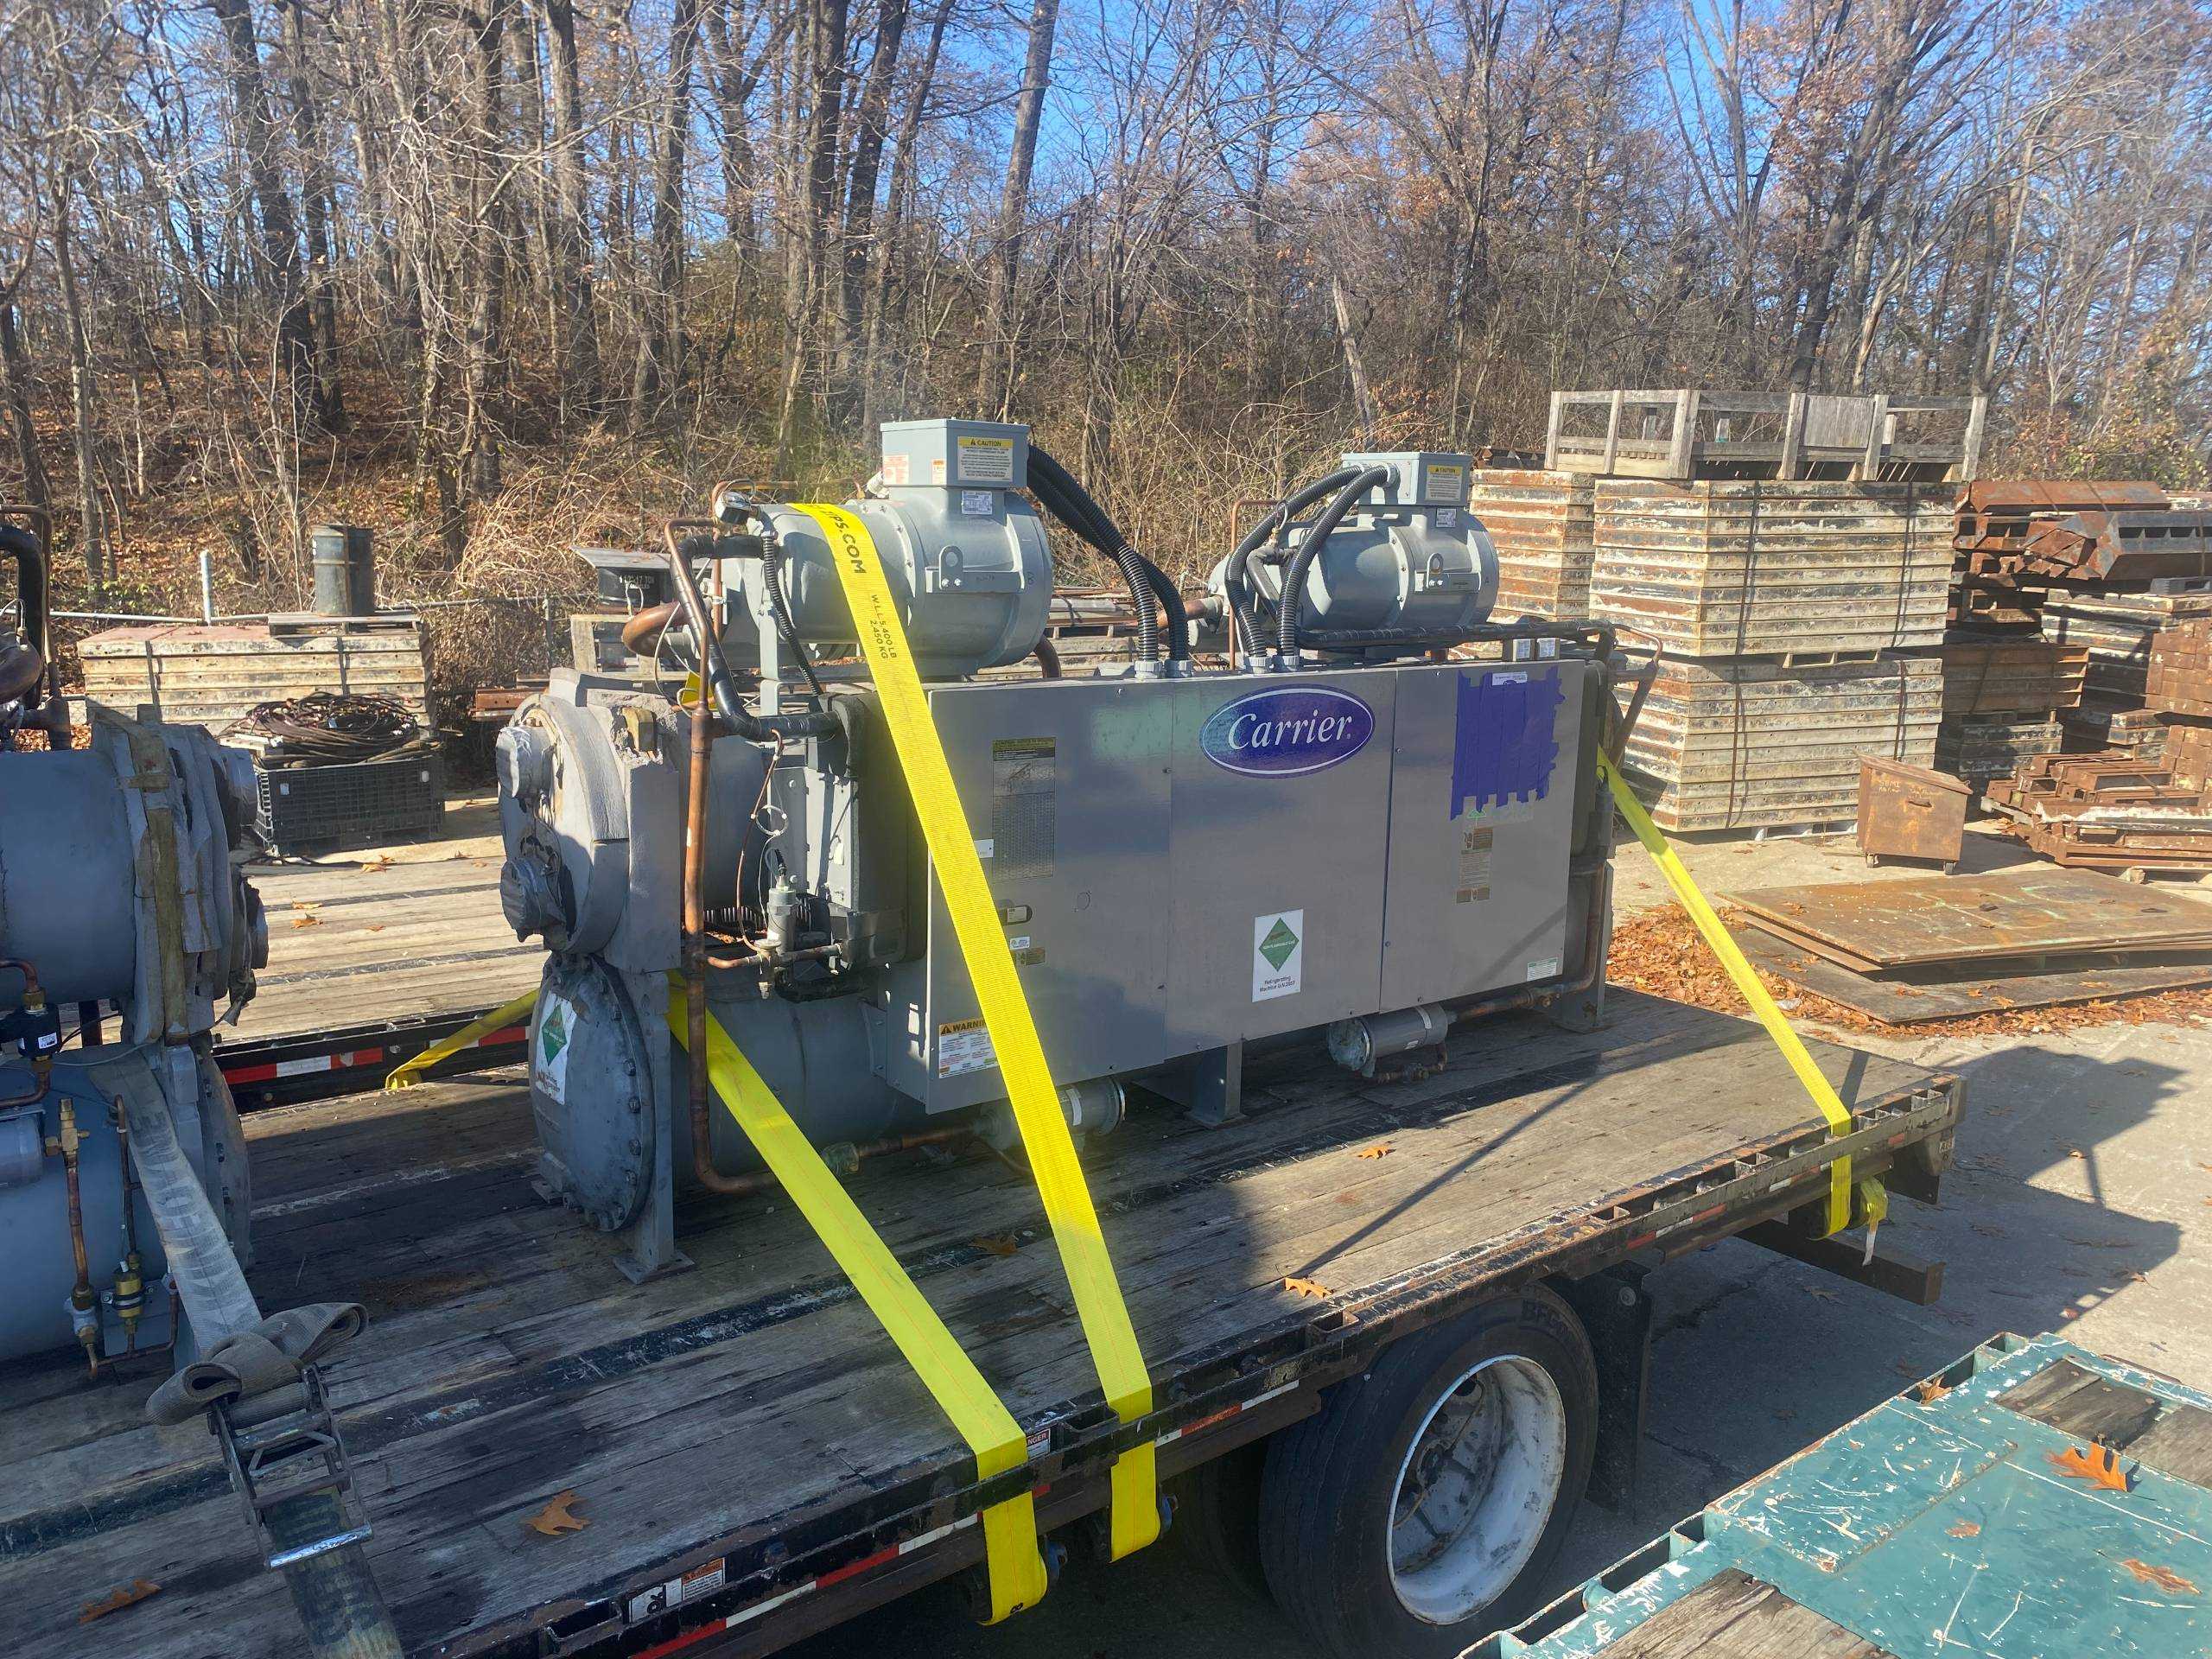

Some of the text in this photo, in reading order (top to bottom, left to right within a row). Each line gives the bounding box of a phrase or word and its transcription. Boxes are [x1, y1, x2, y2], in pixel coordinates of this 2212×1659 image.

[976, 438, 1001, 447] CAUTION
[879, 646, 888, 658] KG
[1228, 709, 1352, 750] Carrier
[952, 1020, 987, 1032] WARNIN
[1027, 1433, 1046, 1445] NGER
